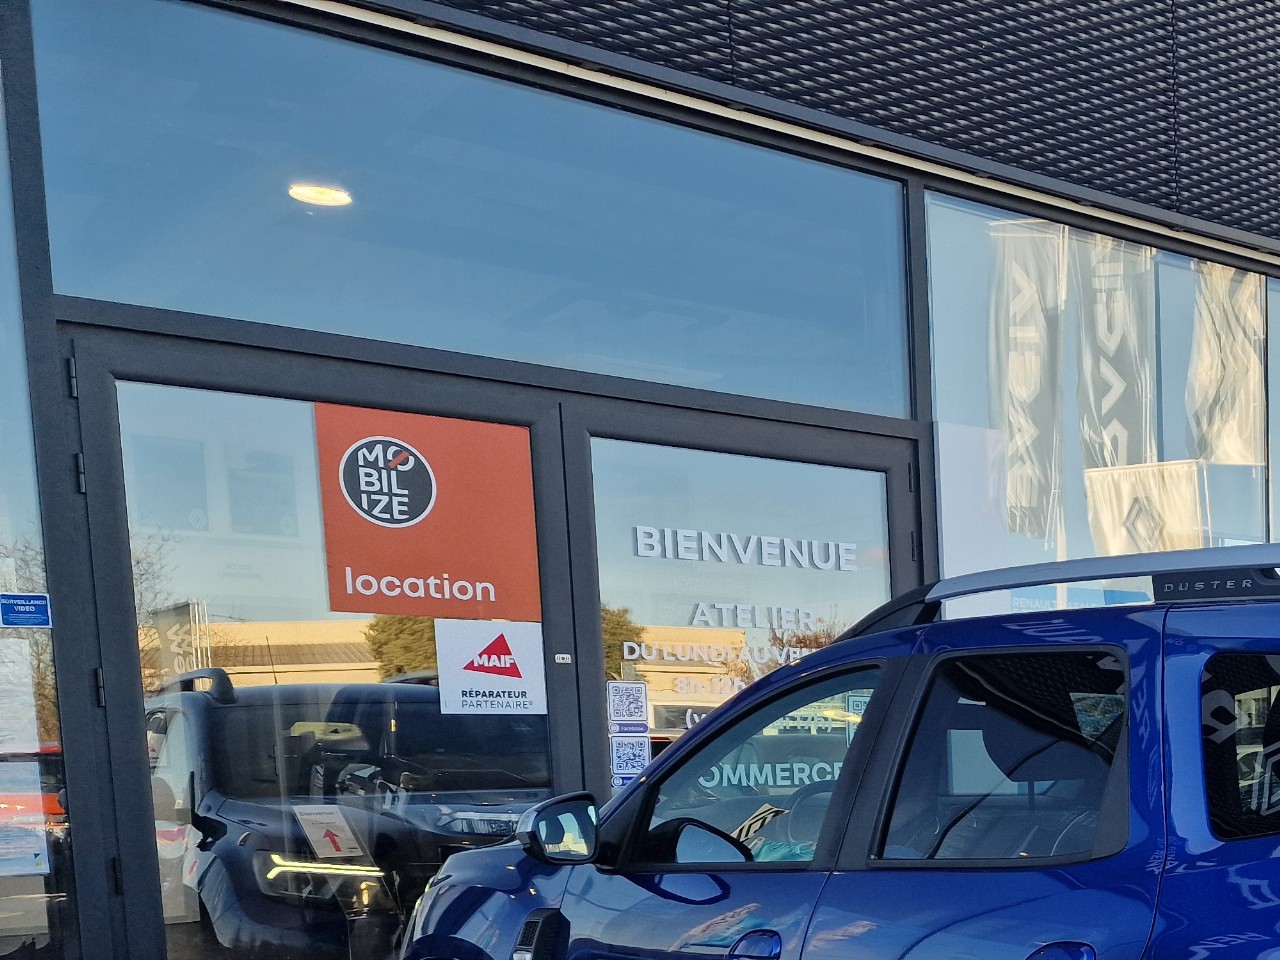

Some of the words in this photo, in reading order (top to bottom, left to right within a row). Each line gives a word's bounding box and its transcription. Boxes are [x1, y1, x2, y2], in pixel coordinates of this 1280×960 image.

[358, 467, 409, 494] BIL
[360, 493, 410, 520] IZE
[634, 525, 858, 571] BIENVENUE
[345, 566, 496, 602] location
[1163, 579, 1253, 592] DUSTER
[690, 602, 817, 631] ATELIER
[474, 653, 515, 668] MAIF
[623, 641, 657, 660] DU
[663, 645, 732, 662] LUNDI
[739, 646, 768, 664] AU
[461, 688, 527, 699] RÉPARATEUR
[698, 762, 843, 787] OMMERC
